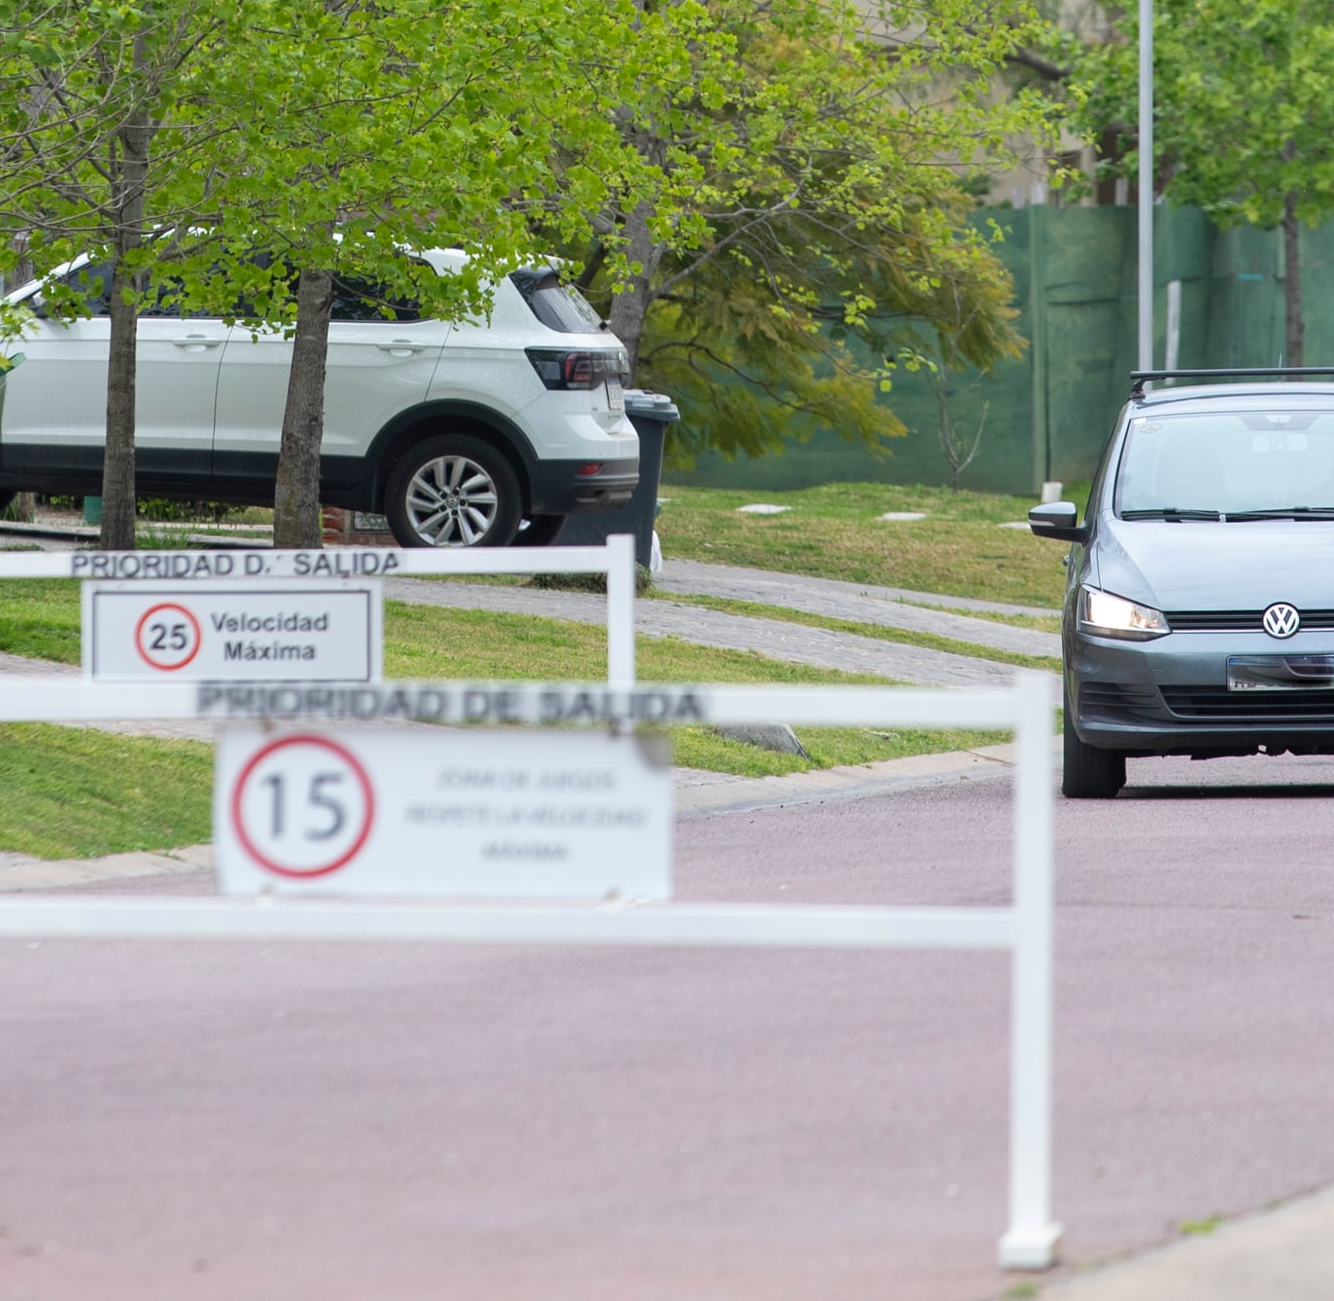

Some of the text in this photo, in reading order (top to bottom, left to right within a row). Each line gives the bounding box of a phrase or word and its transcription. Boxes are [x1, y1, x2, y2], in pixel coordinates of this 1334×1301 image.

[71, 554, 235, 578] PRIORIDAD
[293, 552, 400, 576] SALIDA
[210, 611, 329, 633] Velocidad
[149, 623, 188, 651] 25
[224, 640, 315, 661] Máxima
[197, 680, 706, 722] PRIORIDAD DE SALIDA
[260, 770, 348, 842] 15
